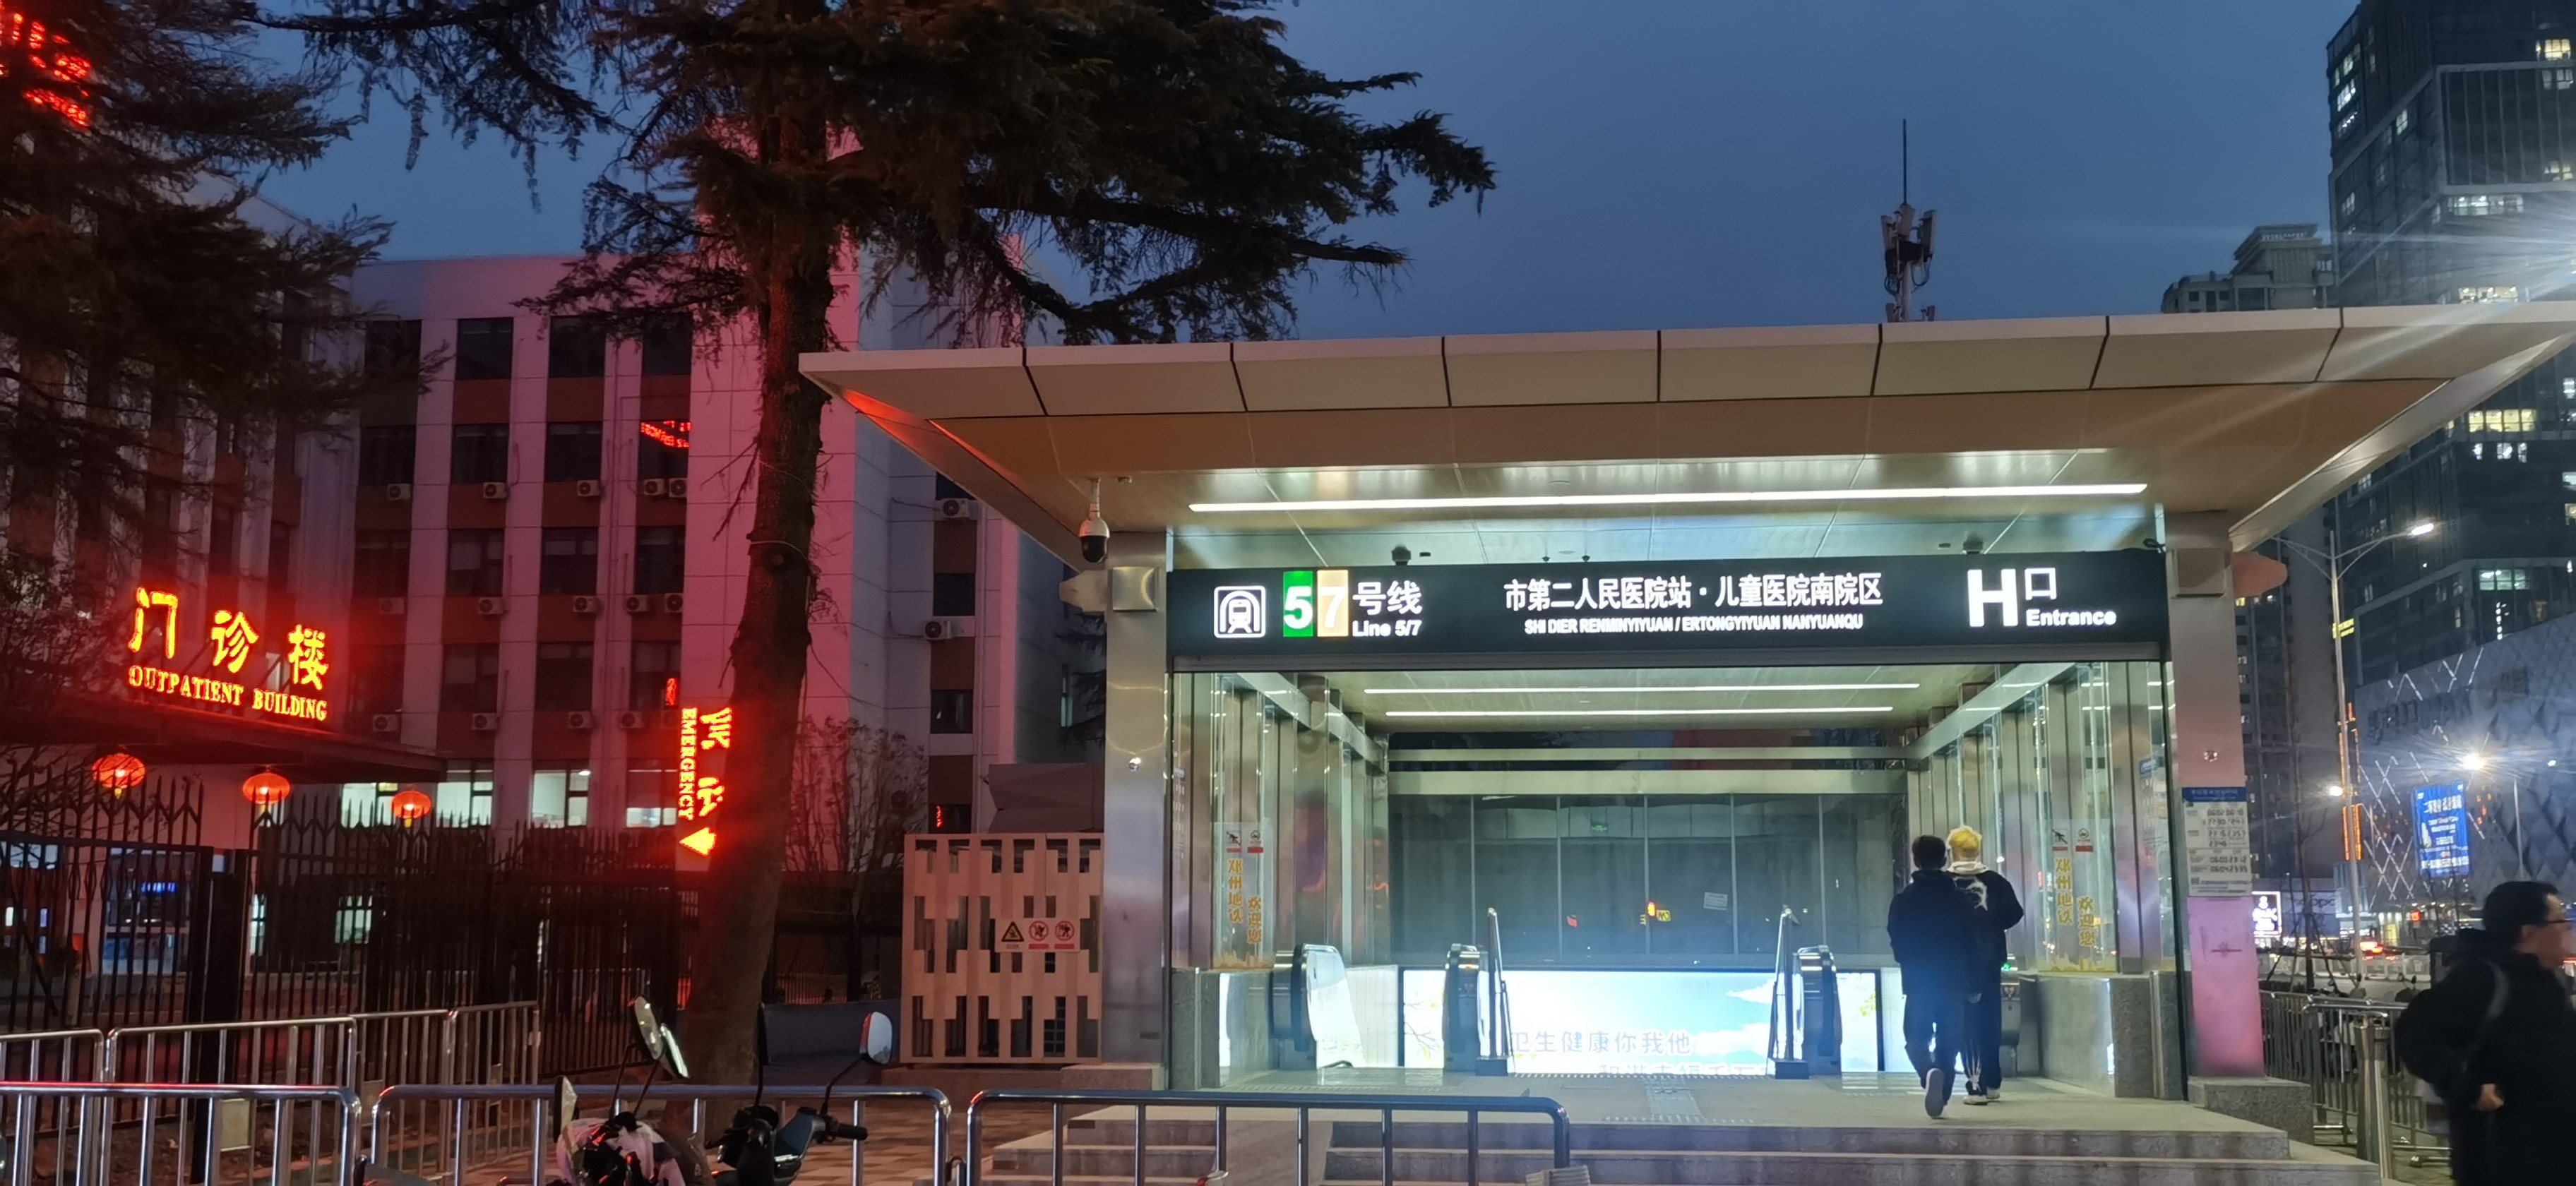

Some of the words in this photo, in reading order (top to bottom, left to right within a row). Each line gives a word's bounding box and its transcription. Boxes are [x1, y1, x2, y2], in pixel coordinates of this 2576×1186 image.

[128, 587, 329, 690] 门诊楼
[1352, 620, 1391, 637] Line
[1395, 619, 1422, 637] 5/7
[1524, 619, 1546, 634] SHI
[1548, 618, 1578, 633] DIER
[1579, 616, 1674, 633] RENMINYIYUAN
[1682, 615, 1781, 632] ERTONGYIYUAN
[1782, 613, 1864, 630] NANYUANQU
[2025, 608, 2117, 627] Entrance
[128, 664, 244, 706] OUTPATIENT
[252, 688, 328, 721] BUILDING
[678, 707, 698, 821] EMERGENCY
[1247, 896, 1262, 945] 欢迎您
[2077, 896, 2096, 946] 欢迎您
[1512, 1031, 1691, 1054] 卫生健康你我他
